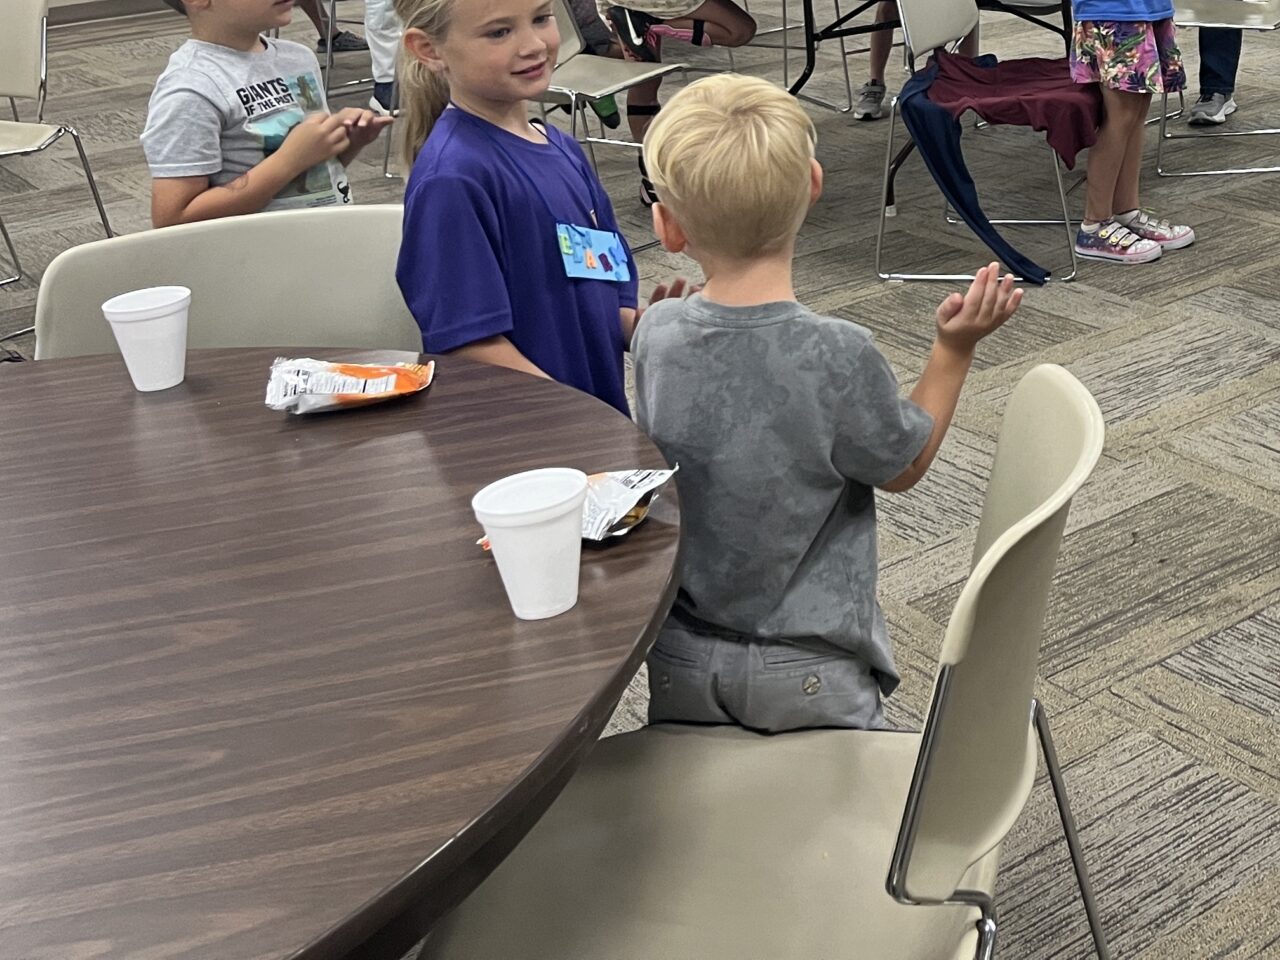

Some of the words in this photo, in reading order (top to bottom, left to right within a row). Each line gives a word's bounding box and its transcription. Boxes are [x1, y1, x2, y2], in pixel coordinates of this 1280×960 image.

[236, 77, 289, 105] GIANTS
[257, 99, 277, 112] THE
[273, 93, 295, 106] PAST
